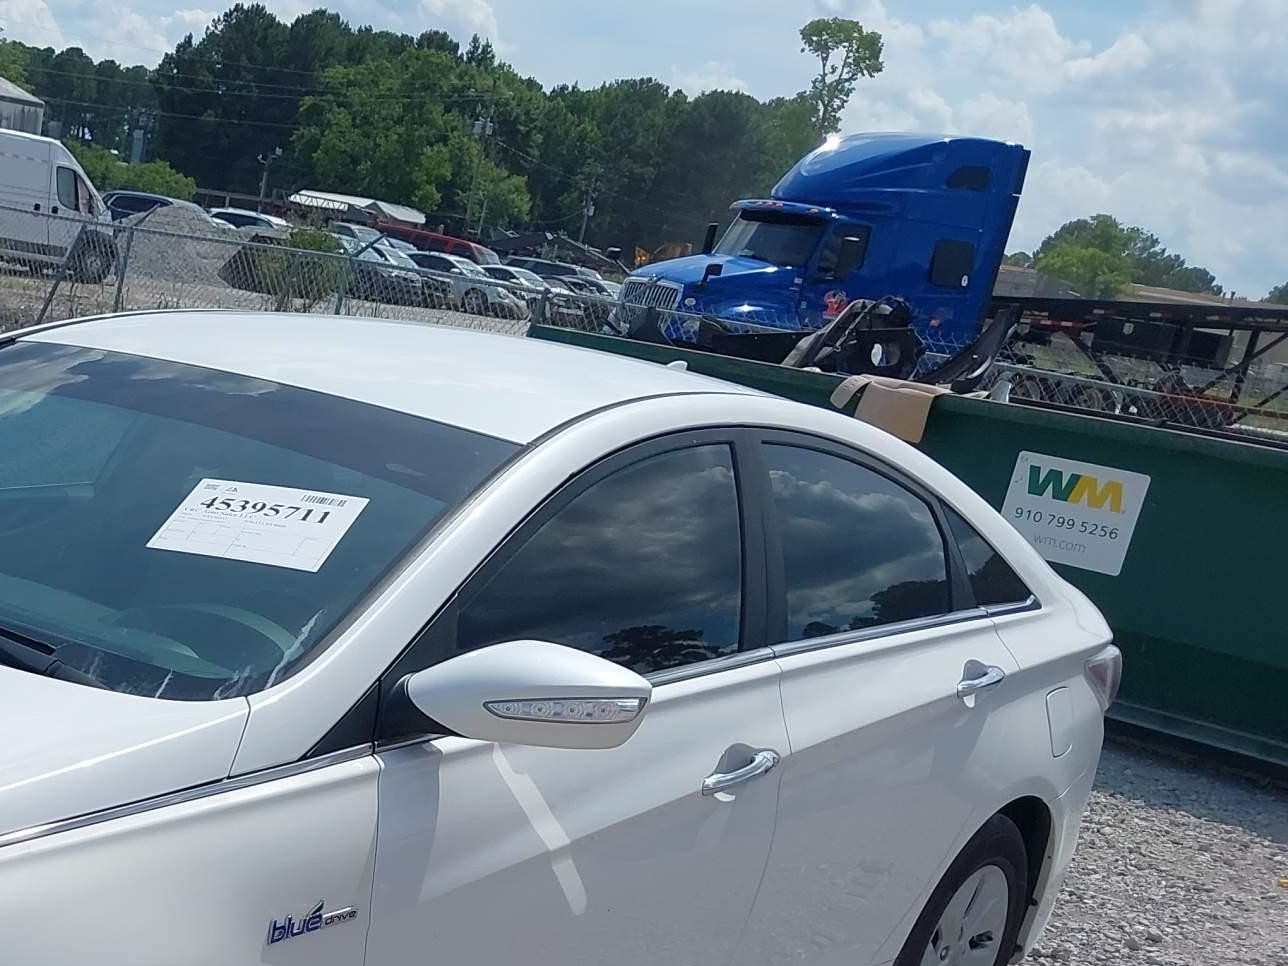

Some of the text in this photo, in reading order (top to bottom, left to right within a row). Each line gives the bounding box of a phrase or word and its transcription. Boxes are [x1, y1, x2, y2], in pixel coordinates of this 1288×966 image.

[1027, 464, 1124, 513] WM
[200, 496, 331, 524] 45395711
[1015, 507, 1120, 540] 910 799 5256
[1033, 534, 1086, 553] wm.com
